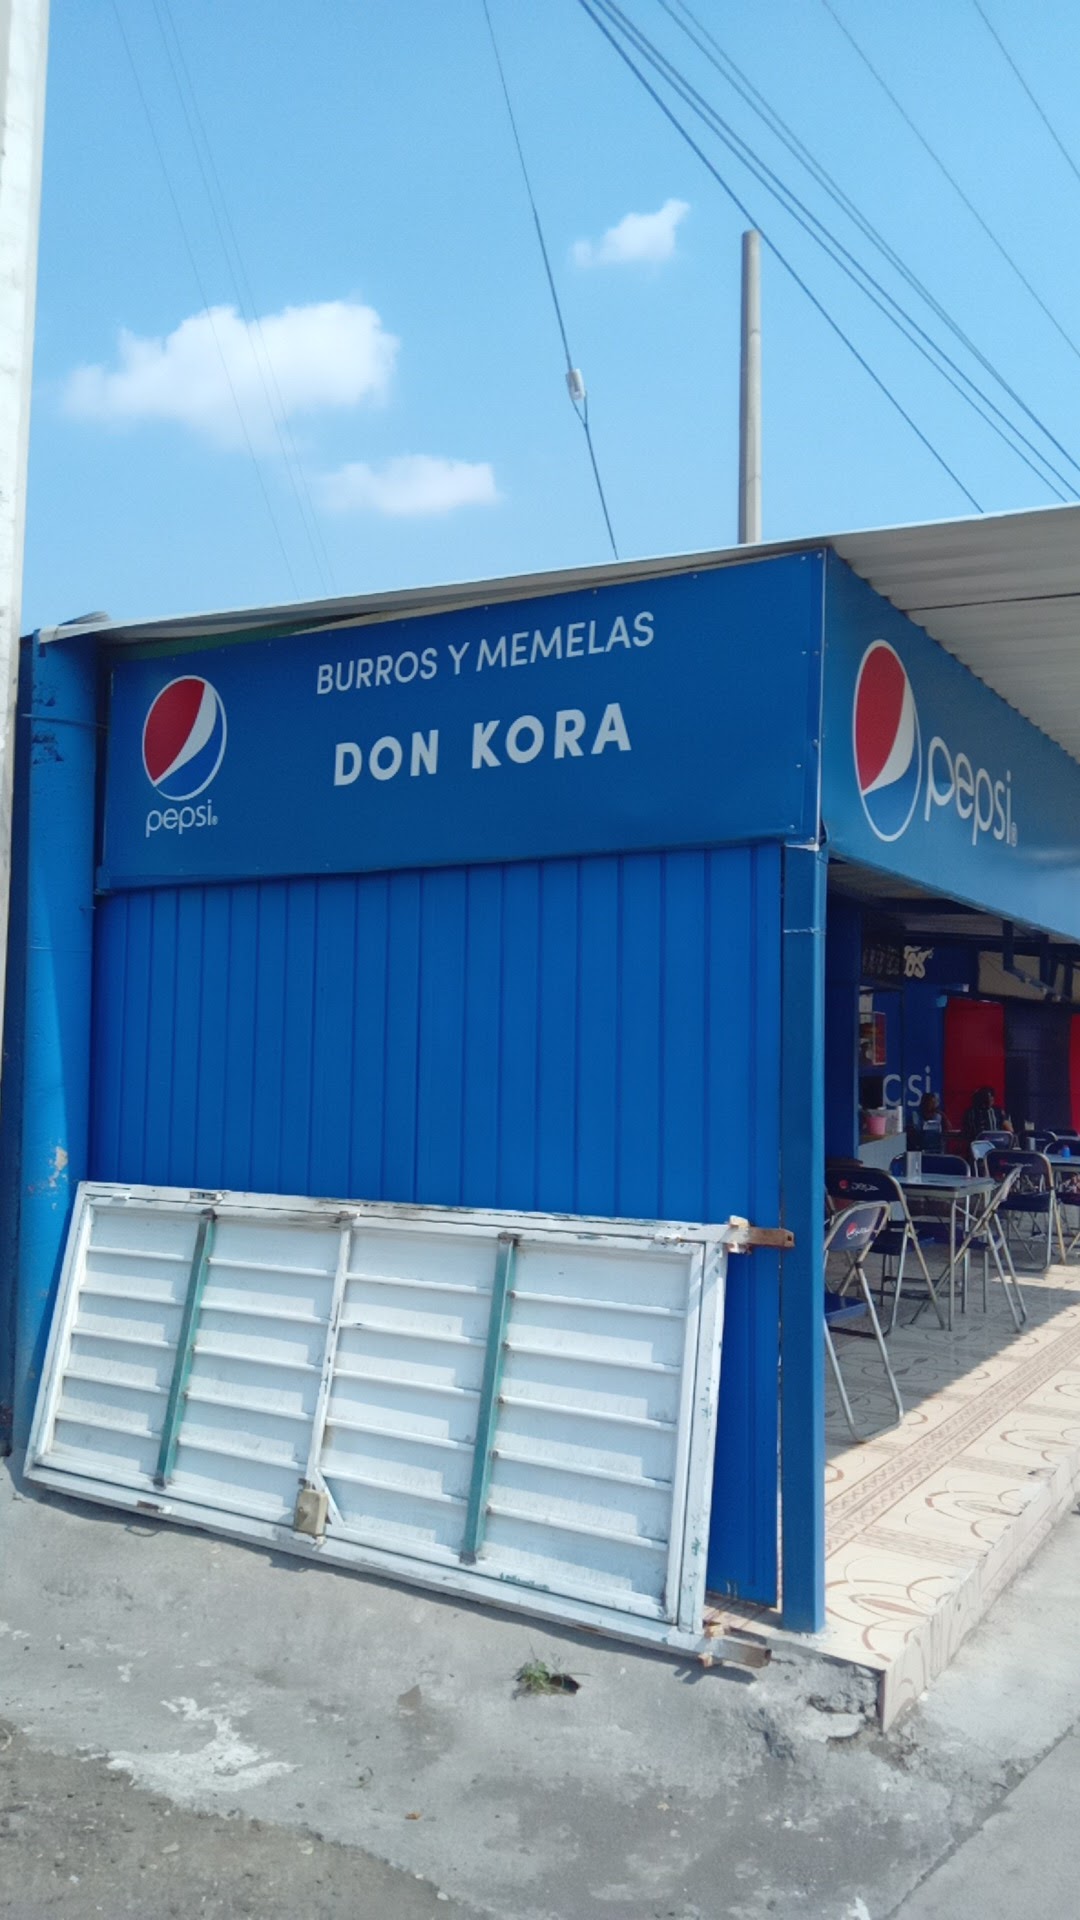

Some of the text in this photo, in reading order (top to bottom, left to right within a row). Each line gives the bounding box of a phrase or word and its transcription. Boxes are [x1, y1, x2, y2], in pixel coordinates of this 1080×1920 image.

[316, 611, 656, 695] BURROS Y MEMELAS
[333, 702, 633, 787] DON KORA
[145, 798, 214, 838] pepsi
[924, 735, 1013, 846] pepsi
